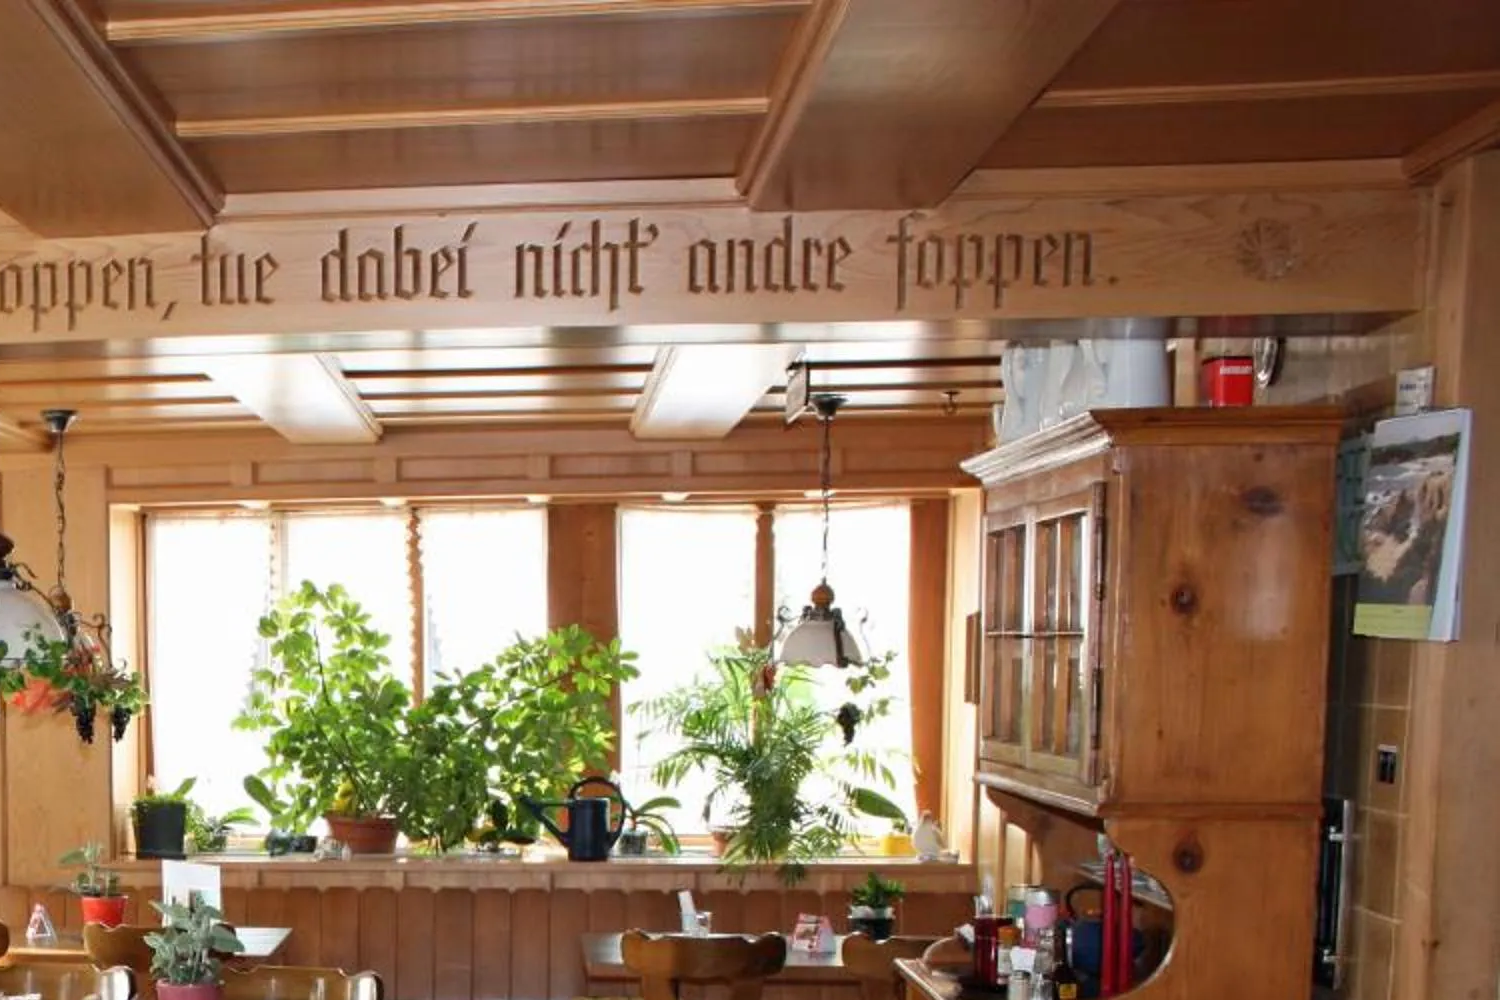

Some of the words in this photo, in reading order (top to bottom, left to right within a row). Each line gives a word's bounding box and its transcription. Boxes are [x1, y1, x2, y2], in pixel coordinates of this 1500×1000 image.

[190, 232, 280, 306] tue
[320, 221, 478, 302] dabei
[514, 217, 660, 311] nicht
[687, 215, 852, 294] andre
[886, 210, 1120, 311] foppen.
